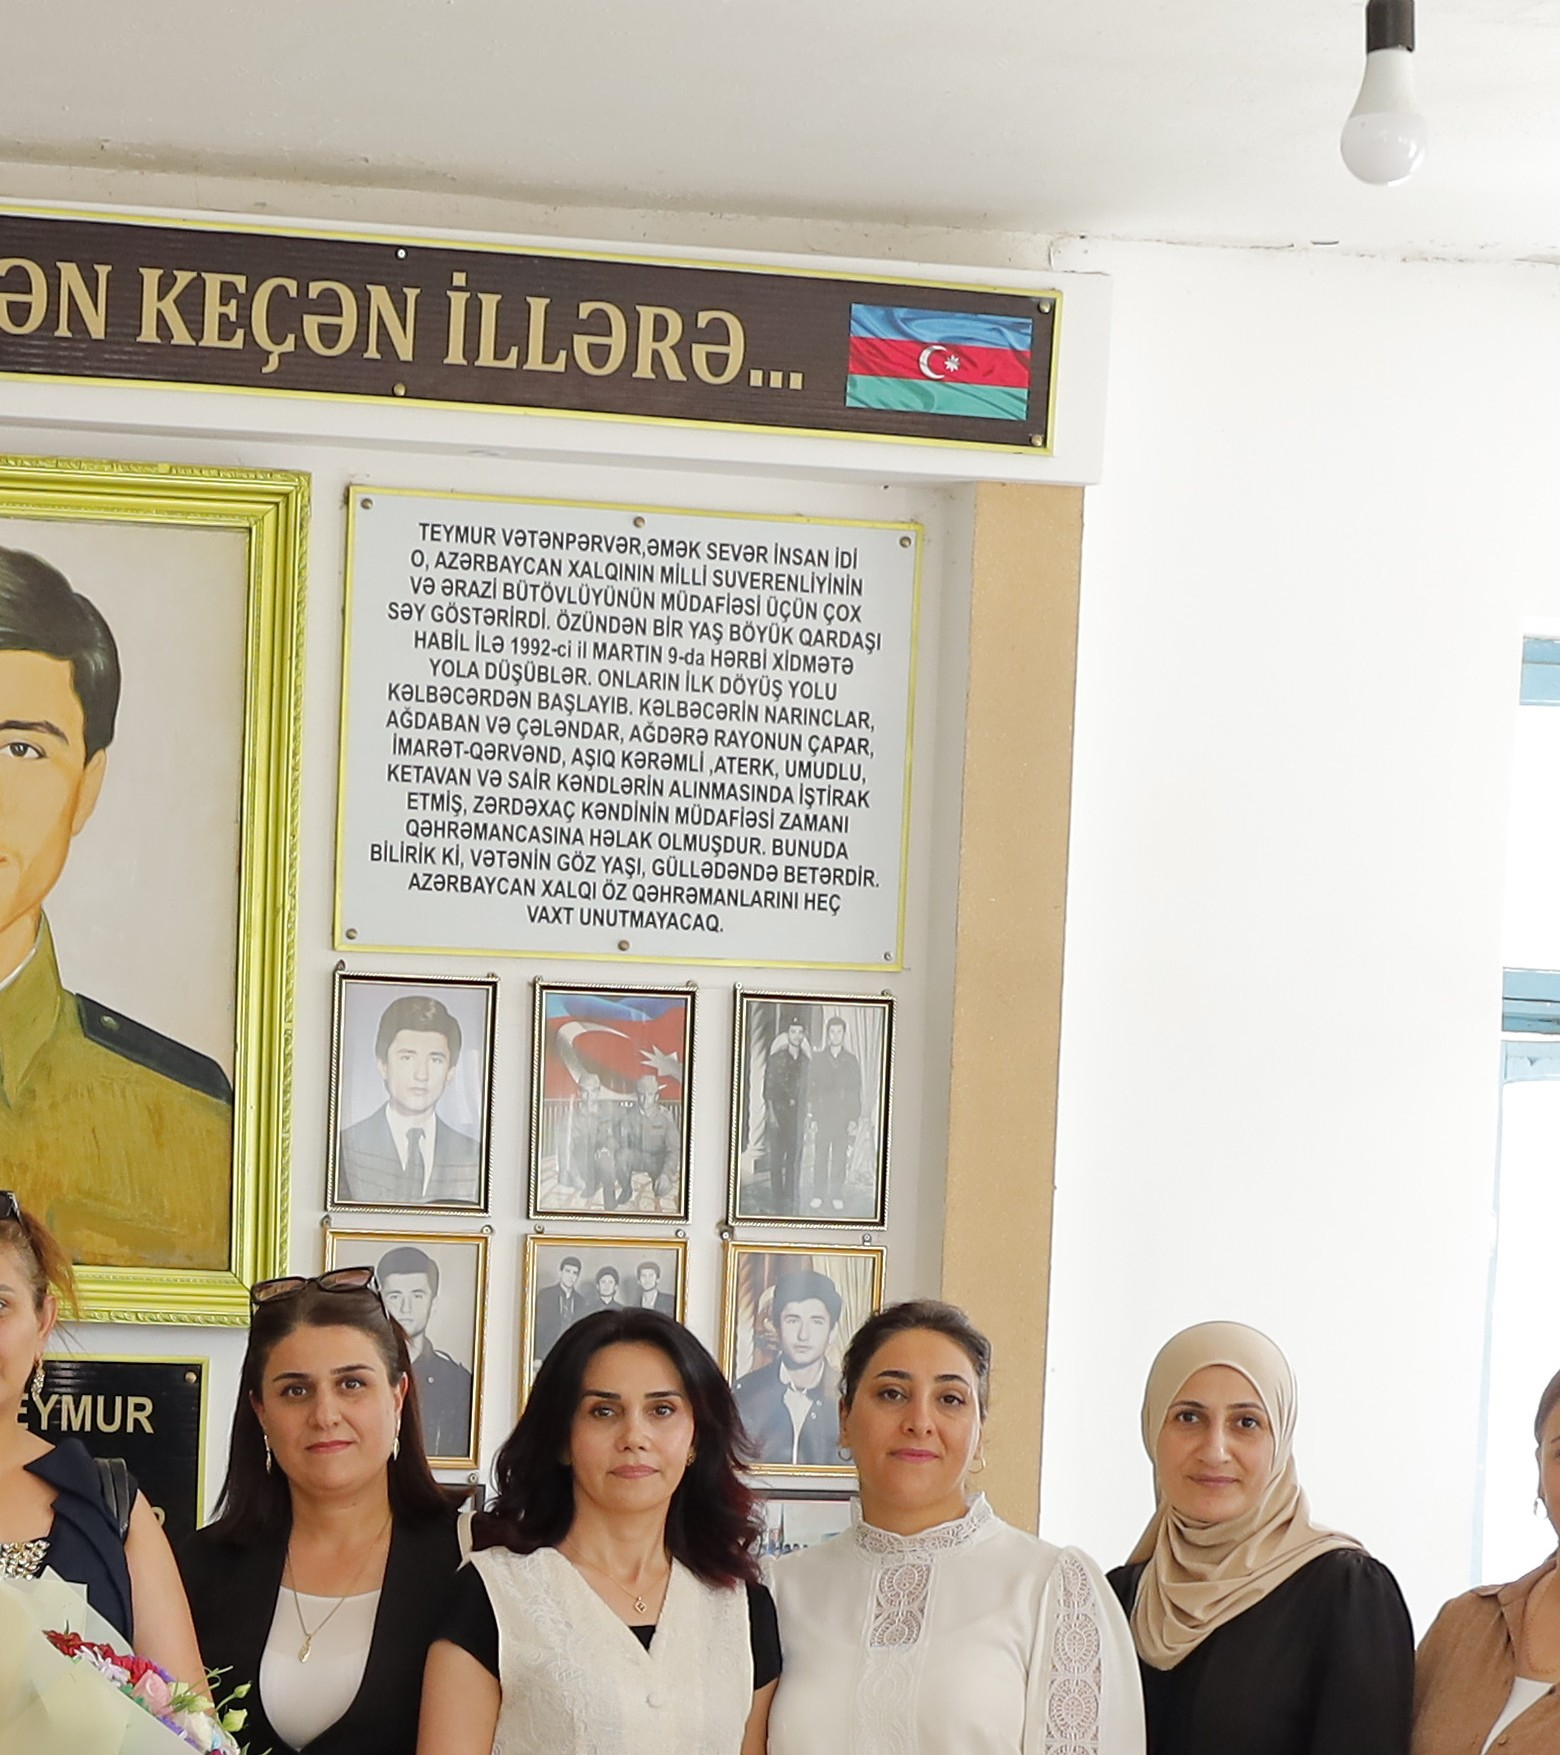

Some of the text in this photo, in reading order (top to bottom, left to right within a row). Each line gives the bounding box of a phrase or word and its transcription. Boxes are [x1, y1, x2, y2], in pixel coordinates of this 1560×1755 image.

[138, 267, 421, 373] KEÇƏN
[443, 272, 805, 392] İLLƏRƏ...
[417, 521, 498, 548] TEYMUR
[704, 540, 770, 566] SEVƏR
[772, 541, 831, 570] İNSAN
[833, 545, 859, 572] İDİ
[409, 547, 864, 598] O, AZƏRBAYCAN XALQININ MİLLİ SUVERENLİYİNİN
[386, 600, 883, 657] SƏY GÖSTƏRİRDİ. ÖZÜNDƏN BİR YAŞ BÖYÜK QARDAŞI
[413, 627, 855, 677] HABİL İLƏ 1992-ci il MARTIN 9-da HƏRBİ XİDMƏTƏ
[427, 656, 839, 704] YOLA DÜŞÜBLƏR. ONLARIN İLK DÖYÜŞ YOLU
[384, 704, 875, 761] AĞDABAN VƏ ÇƏLƏNDAR, AĞDƏRƏ RAYONUN ÇAPAR,
[386, 681, 876, 735] KƏLBƏCƏRDƏN BAŞLAYIB. KƏLBƏCƏRİN NARINCLAR,
[391, 731, 568, 770] İMARƏT-QƏRVƏND,
[569, 745, 617, 773] AŞIQ
[783, 757, 867, 787] UMUDLU,
[406, 787, 850, 835] ETMİŞ, ZƏRDƏXAÇ KƏNDİNİN MÜDAFİƏSİ ZAMANI
[404, 817, 850, 862] QƏHRƏMANCASINA HƏLAK OLMUŞDUR. BUNUDA
[406, 870, 843, 918] AZƏRBAYCAN XALQI ÖZ QƏHRƏMANLARINI HEÇ
[525, 903, 725, 935] VAXT UNUTMAYACAQ.
[17, 1394, 154, 1434] EYMUR
